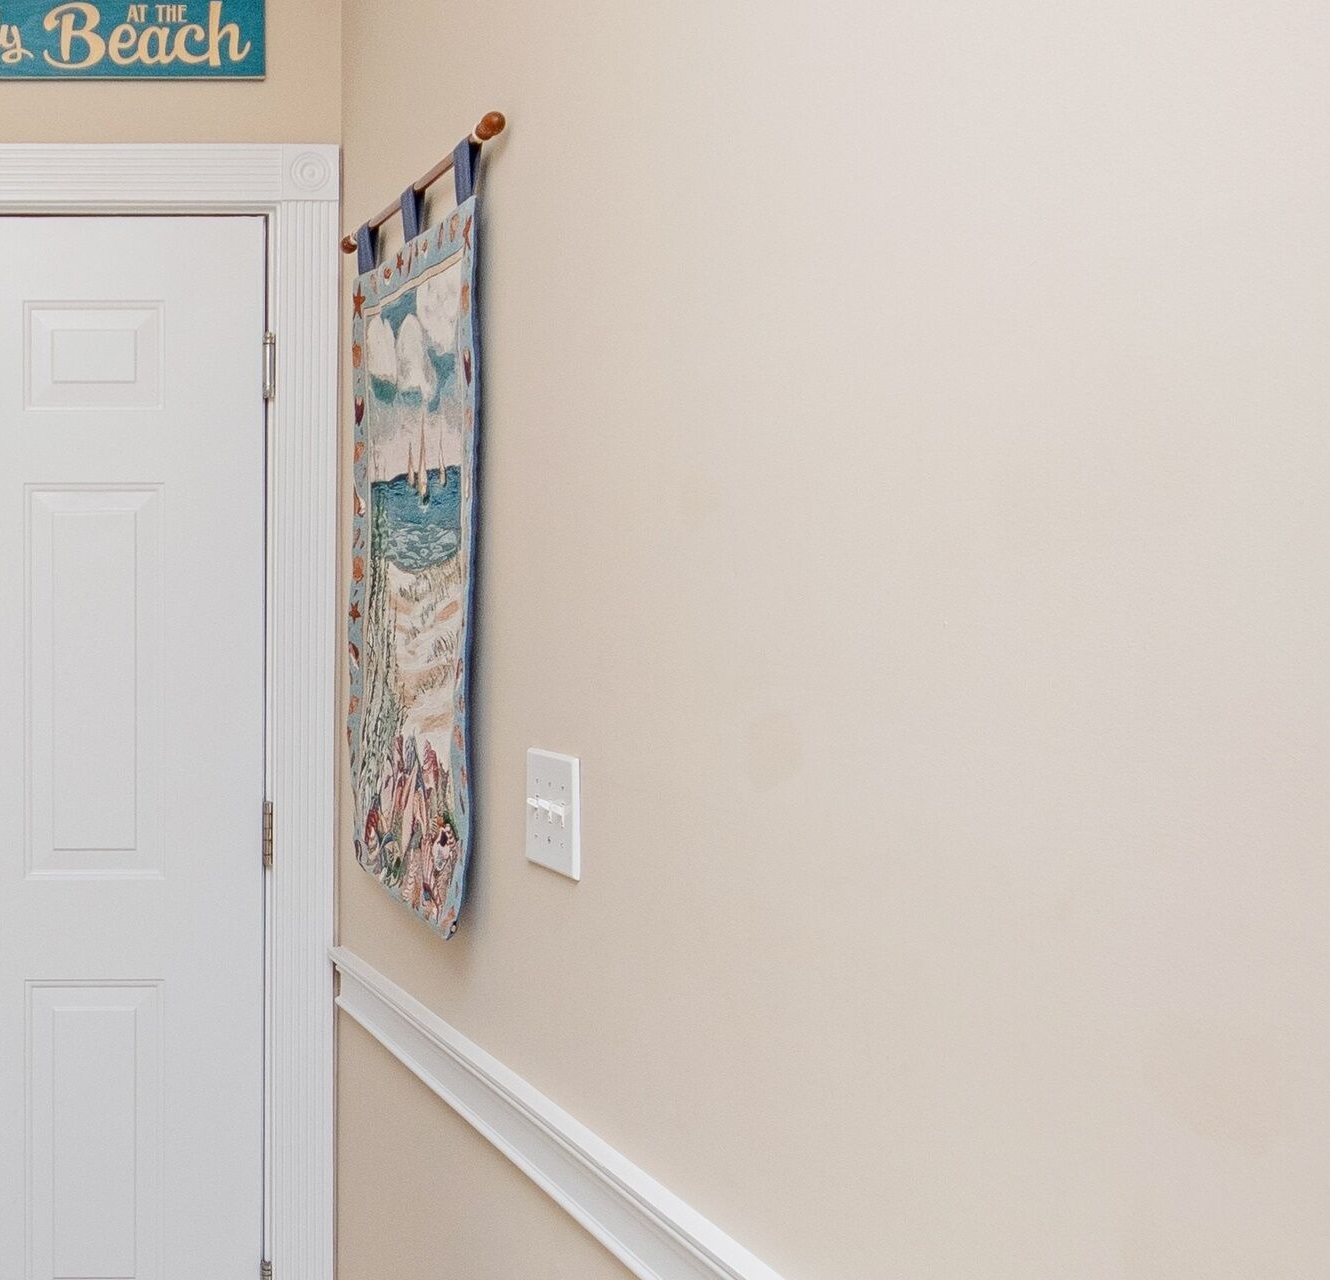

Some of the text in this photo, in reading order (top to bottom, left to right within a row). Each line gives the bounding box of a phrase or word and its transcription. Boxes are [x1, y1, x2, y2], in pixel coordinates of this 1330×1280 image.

[126, 4, 148, 23] AT
[155, 4, 188, 23] THE
[43, 0, 251, 68] Beach
